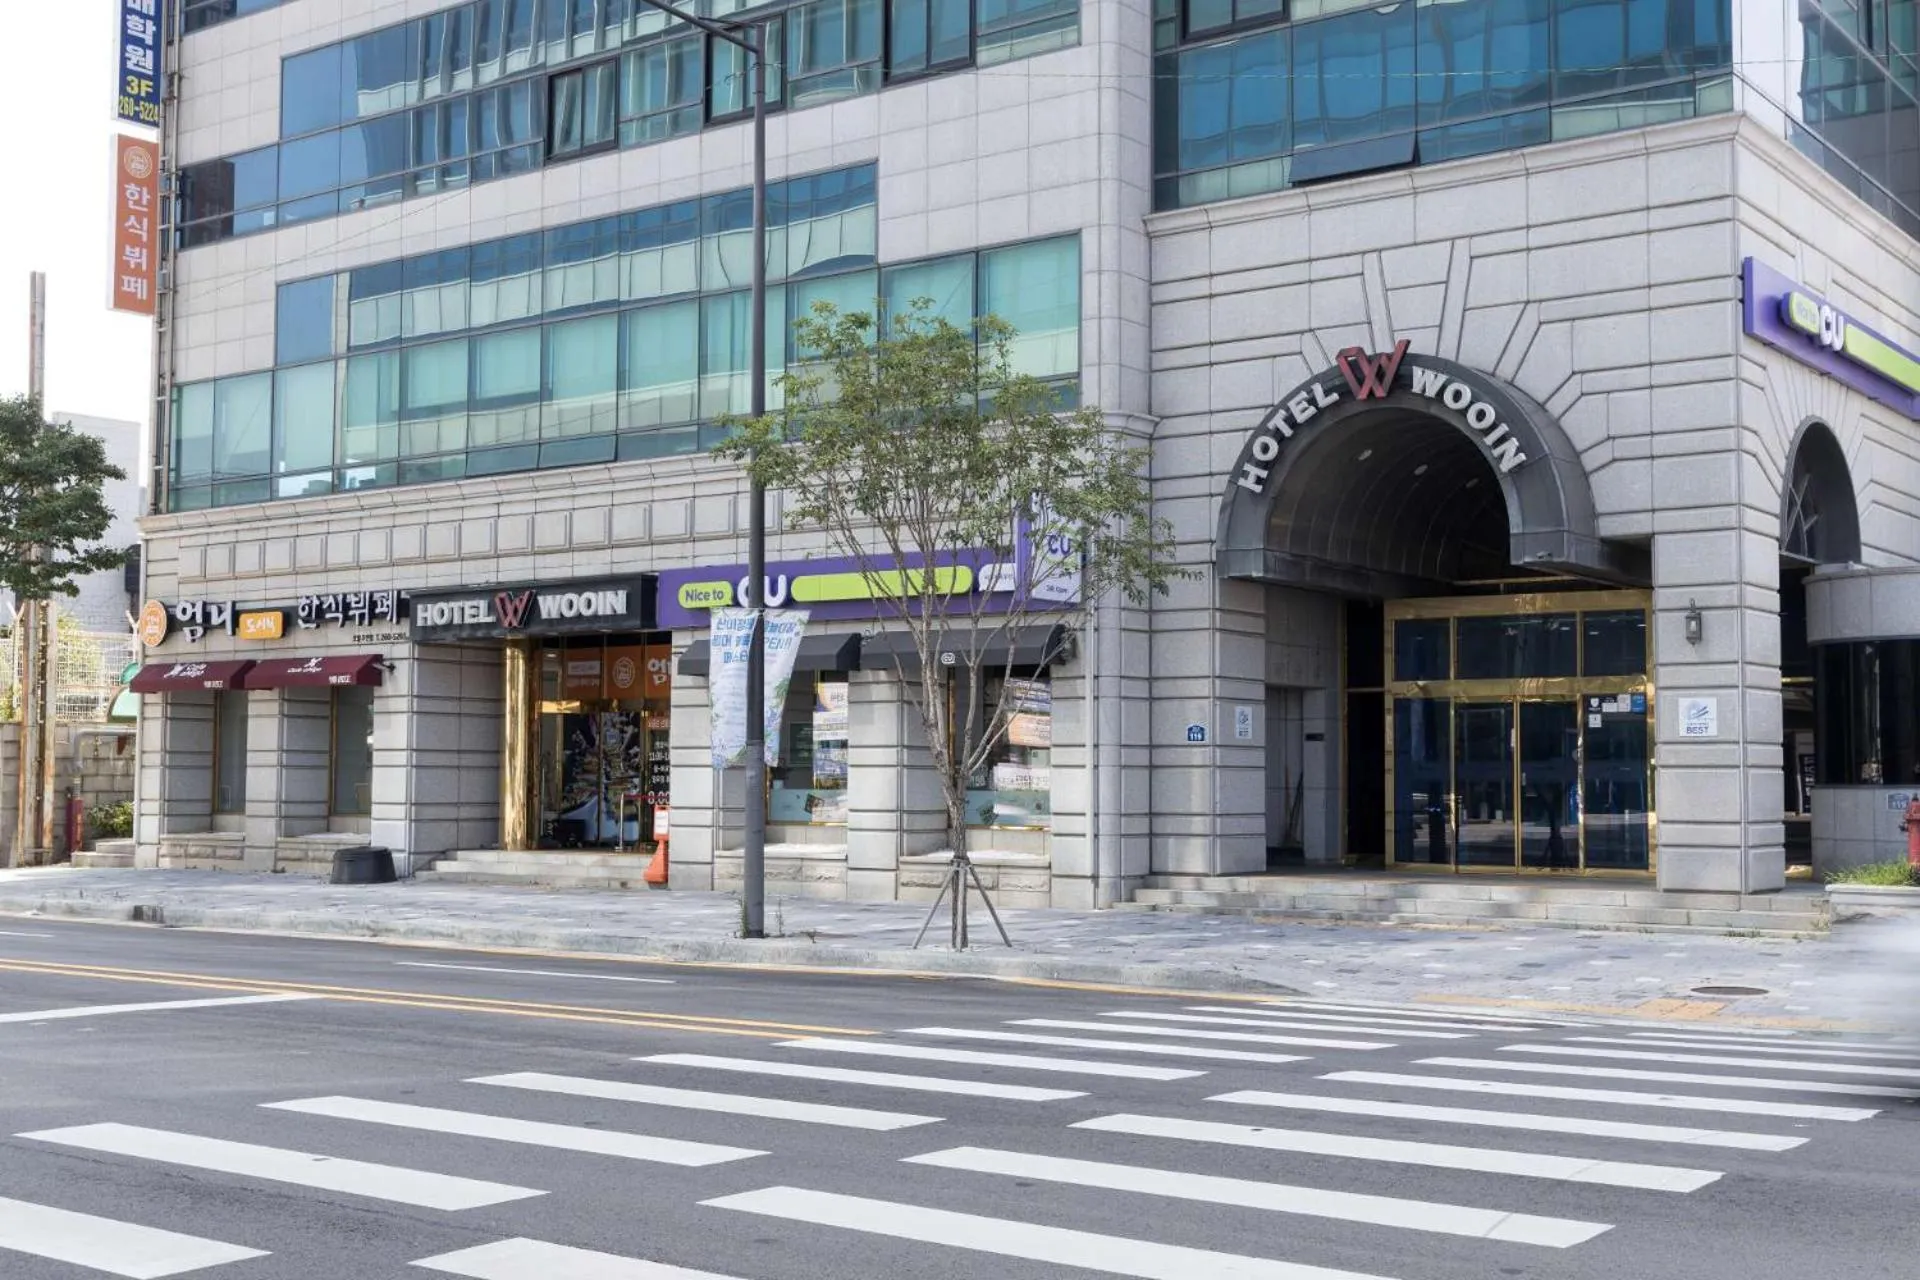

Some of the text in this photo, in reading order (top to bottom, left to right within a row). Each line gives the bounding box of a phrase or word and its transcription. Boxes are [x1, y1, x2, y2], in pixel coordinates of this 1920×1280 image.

[126, 75, 154, 97] 3F
[121, 183, 149, 301] 한식뷔페
[1820, 305, 1844, 351] CU
[1238, 382, 1340, 493] HOTEL
[1412, 366, 1527, 473] WOOIN
[1048, 534, 1071, 555] CU
[297, 589, 400, 630] 한식뷔페
[416, 599, 497, 627] HOTEL
[536, 589, 628, 620] WOOIN
[685, 587, 724, 602] Nice to
[176, 600, 234, 643] 엄니
[1686, 726, 1709, 734] BEST
